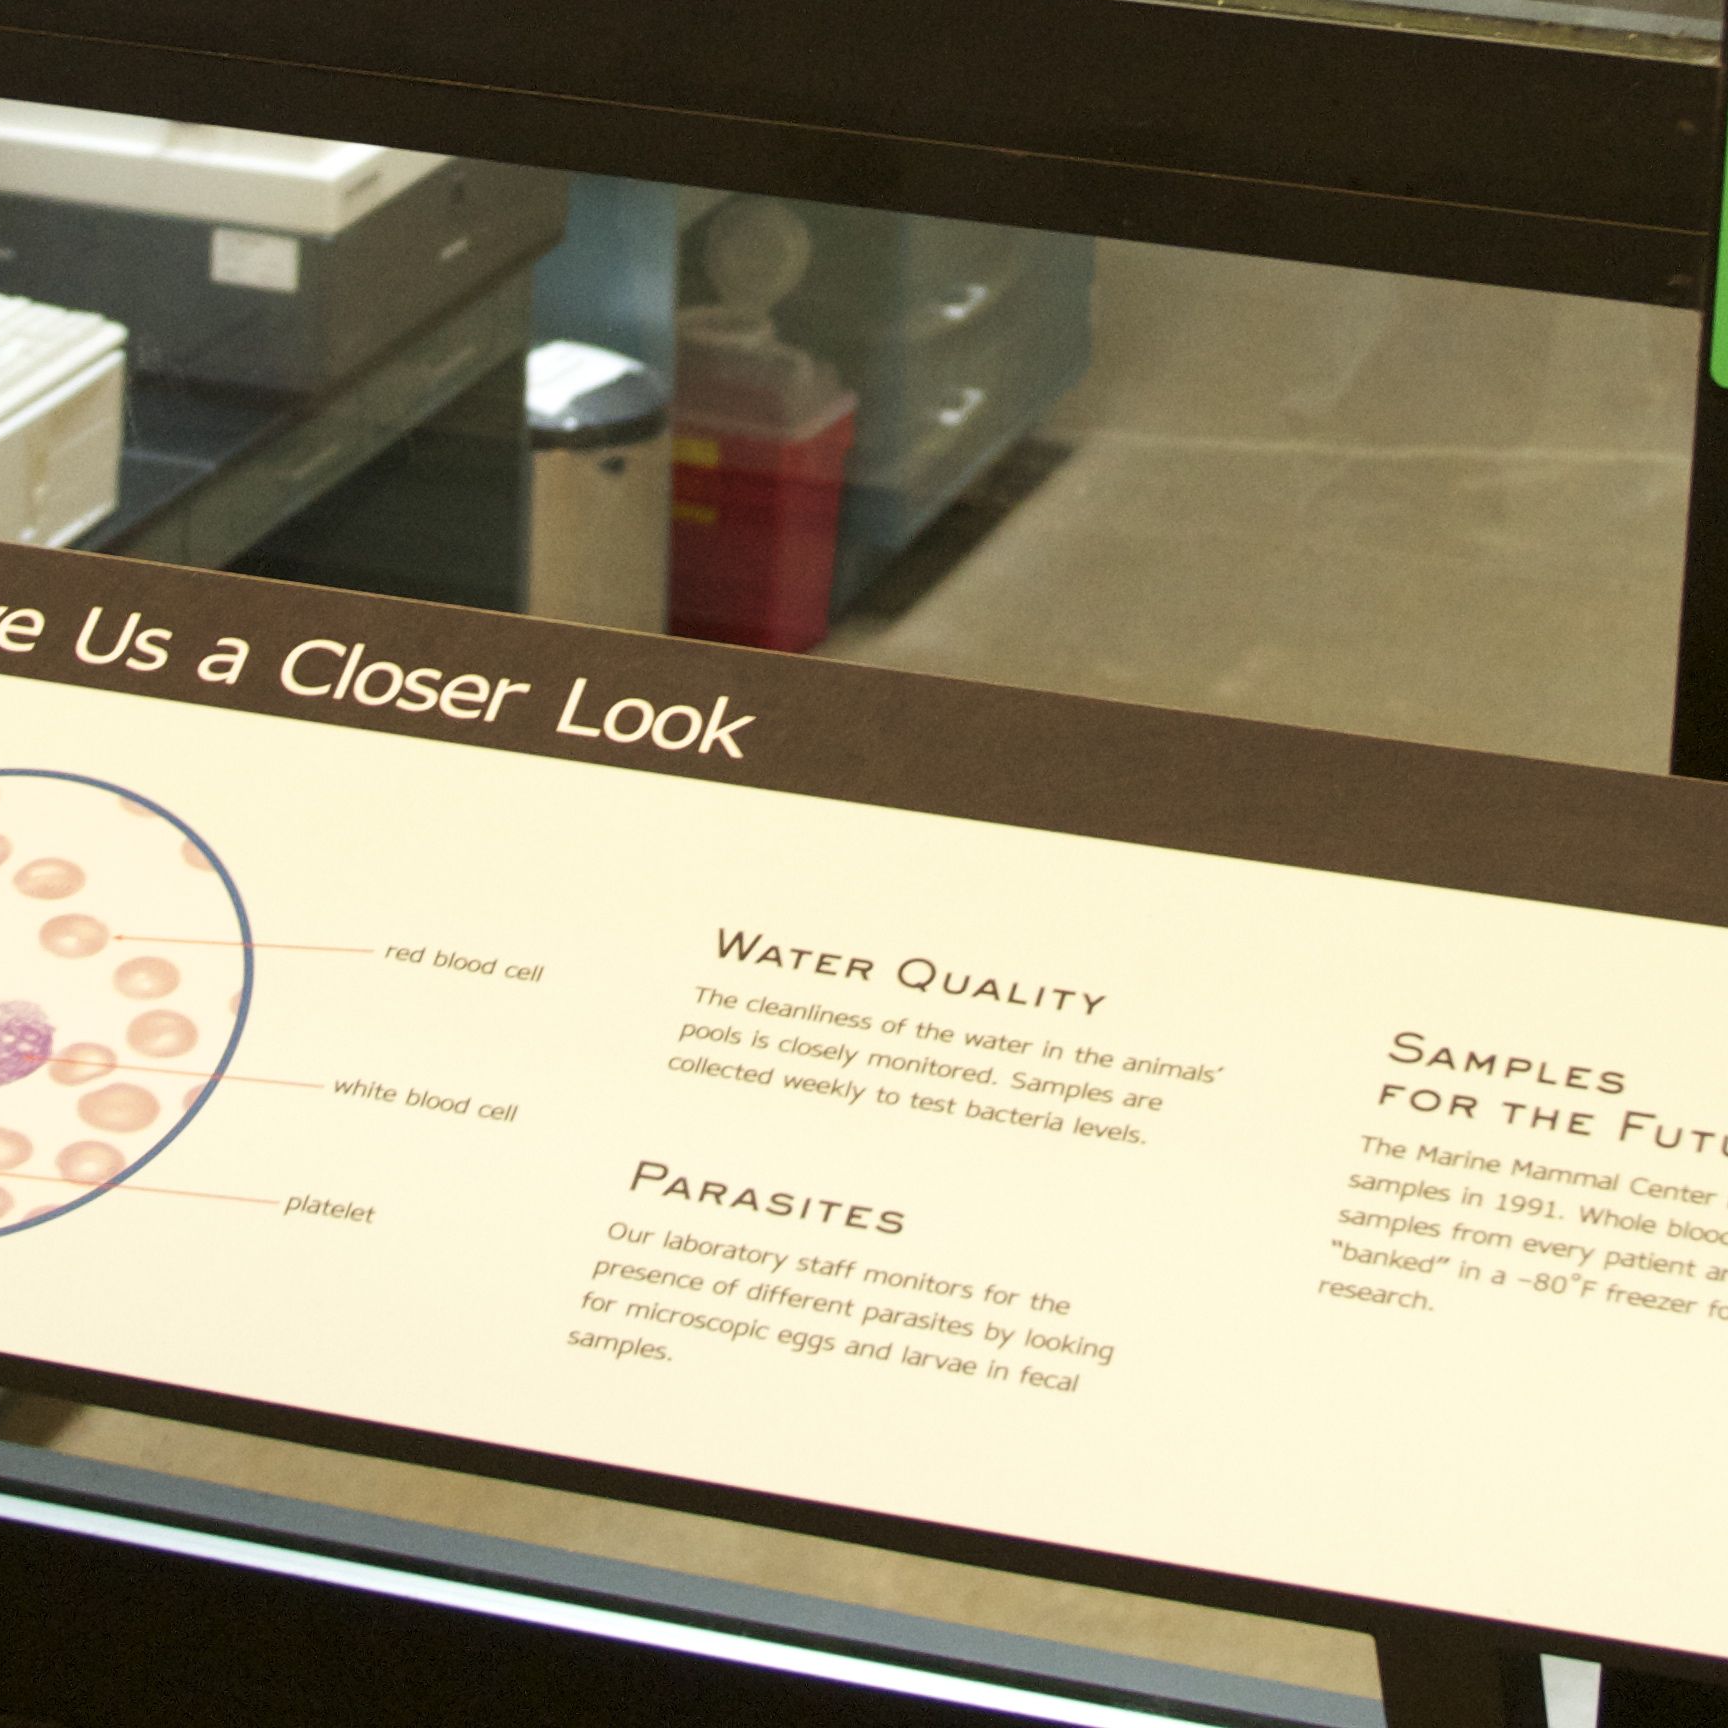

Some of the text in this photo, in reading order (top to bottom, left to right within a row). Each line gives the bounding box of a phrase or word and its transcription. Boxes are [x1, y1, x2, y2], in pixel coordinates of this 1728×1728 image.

[75, 607, 172, 671] Us
[197, 637, 249, 685] a
[280, 639, 531, 722] Closer
[556, 678, 755, 758] Look
[385, 946, 544, 982] red blood cell
[717, 927, 1107, 1016] WATER QUALITY
[695, 985, 739, 1010] The
[745, 996, 872, 1031] cleanliness
[880, 1017, 909, 1035] of
[915, 1022, 955, 1044] the
[964, 1032, 1034, 1055] water
[1041, 1040, 1064, 1060] in
[1074, 1046, 1115, 1069] the
[677, 1023, 1164, 1112] pools is closely monitored. Samples are
[1387, 1030, 1626, 1096] SAMPLES
[334, 1079, 518, 1122] white blood cell
[667, 1056, 1146, 1145] collected weekly to test bacteria levels.
[1378, 1083, 1479, 1120] FOR
[1501, 1101, 1596, 1137] THE
[629, 1159, 905, 1236] PARASITES
[1348, 1173, 1451, 1203] samples
[1460, 1186, 1484, 1208] in
[1495, 1193, 1564, 1220] 1991.
[1579, 1205, 1658, 1235] Whole
[1361, 1134, 1408, 1160] The
[1415, 1144, 1502, 1174] Marine
[1510, 1158, 1621, 1192] Mammal
[1629, 1176, 1718, 1206] Center
[283, 1195, 375, 1224] platelet
[1338, 1209, 1441, 1238] samples
[1451, 1222, 1513, 1249] from
[1522, 1237, 1596, 1268] every
[1603, 1250, 1697, 1278] patient
[607, 1221, 1071, 1316] Our laboratory staff monitors for the
[1317, 1279, 1434, 1311] research.
[1458, 1260, 1482, 1281] in
[1490, 1269, 1507, 1286] a
[1606, 1283, 1698, 1314] freezer
[567, 1330, 672, 1362] samples.
[581, 1290, 1080, 1393] for microscopic eggs and larvae in fecal
[591, 1260, 1115, 1367] presence of different parasites by looking
